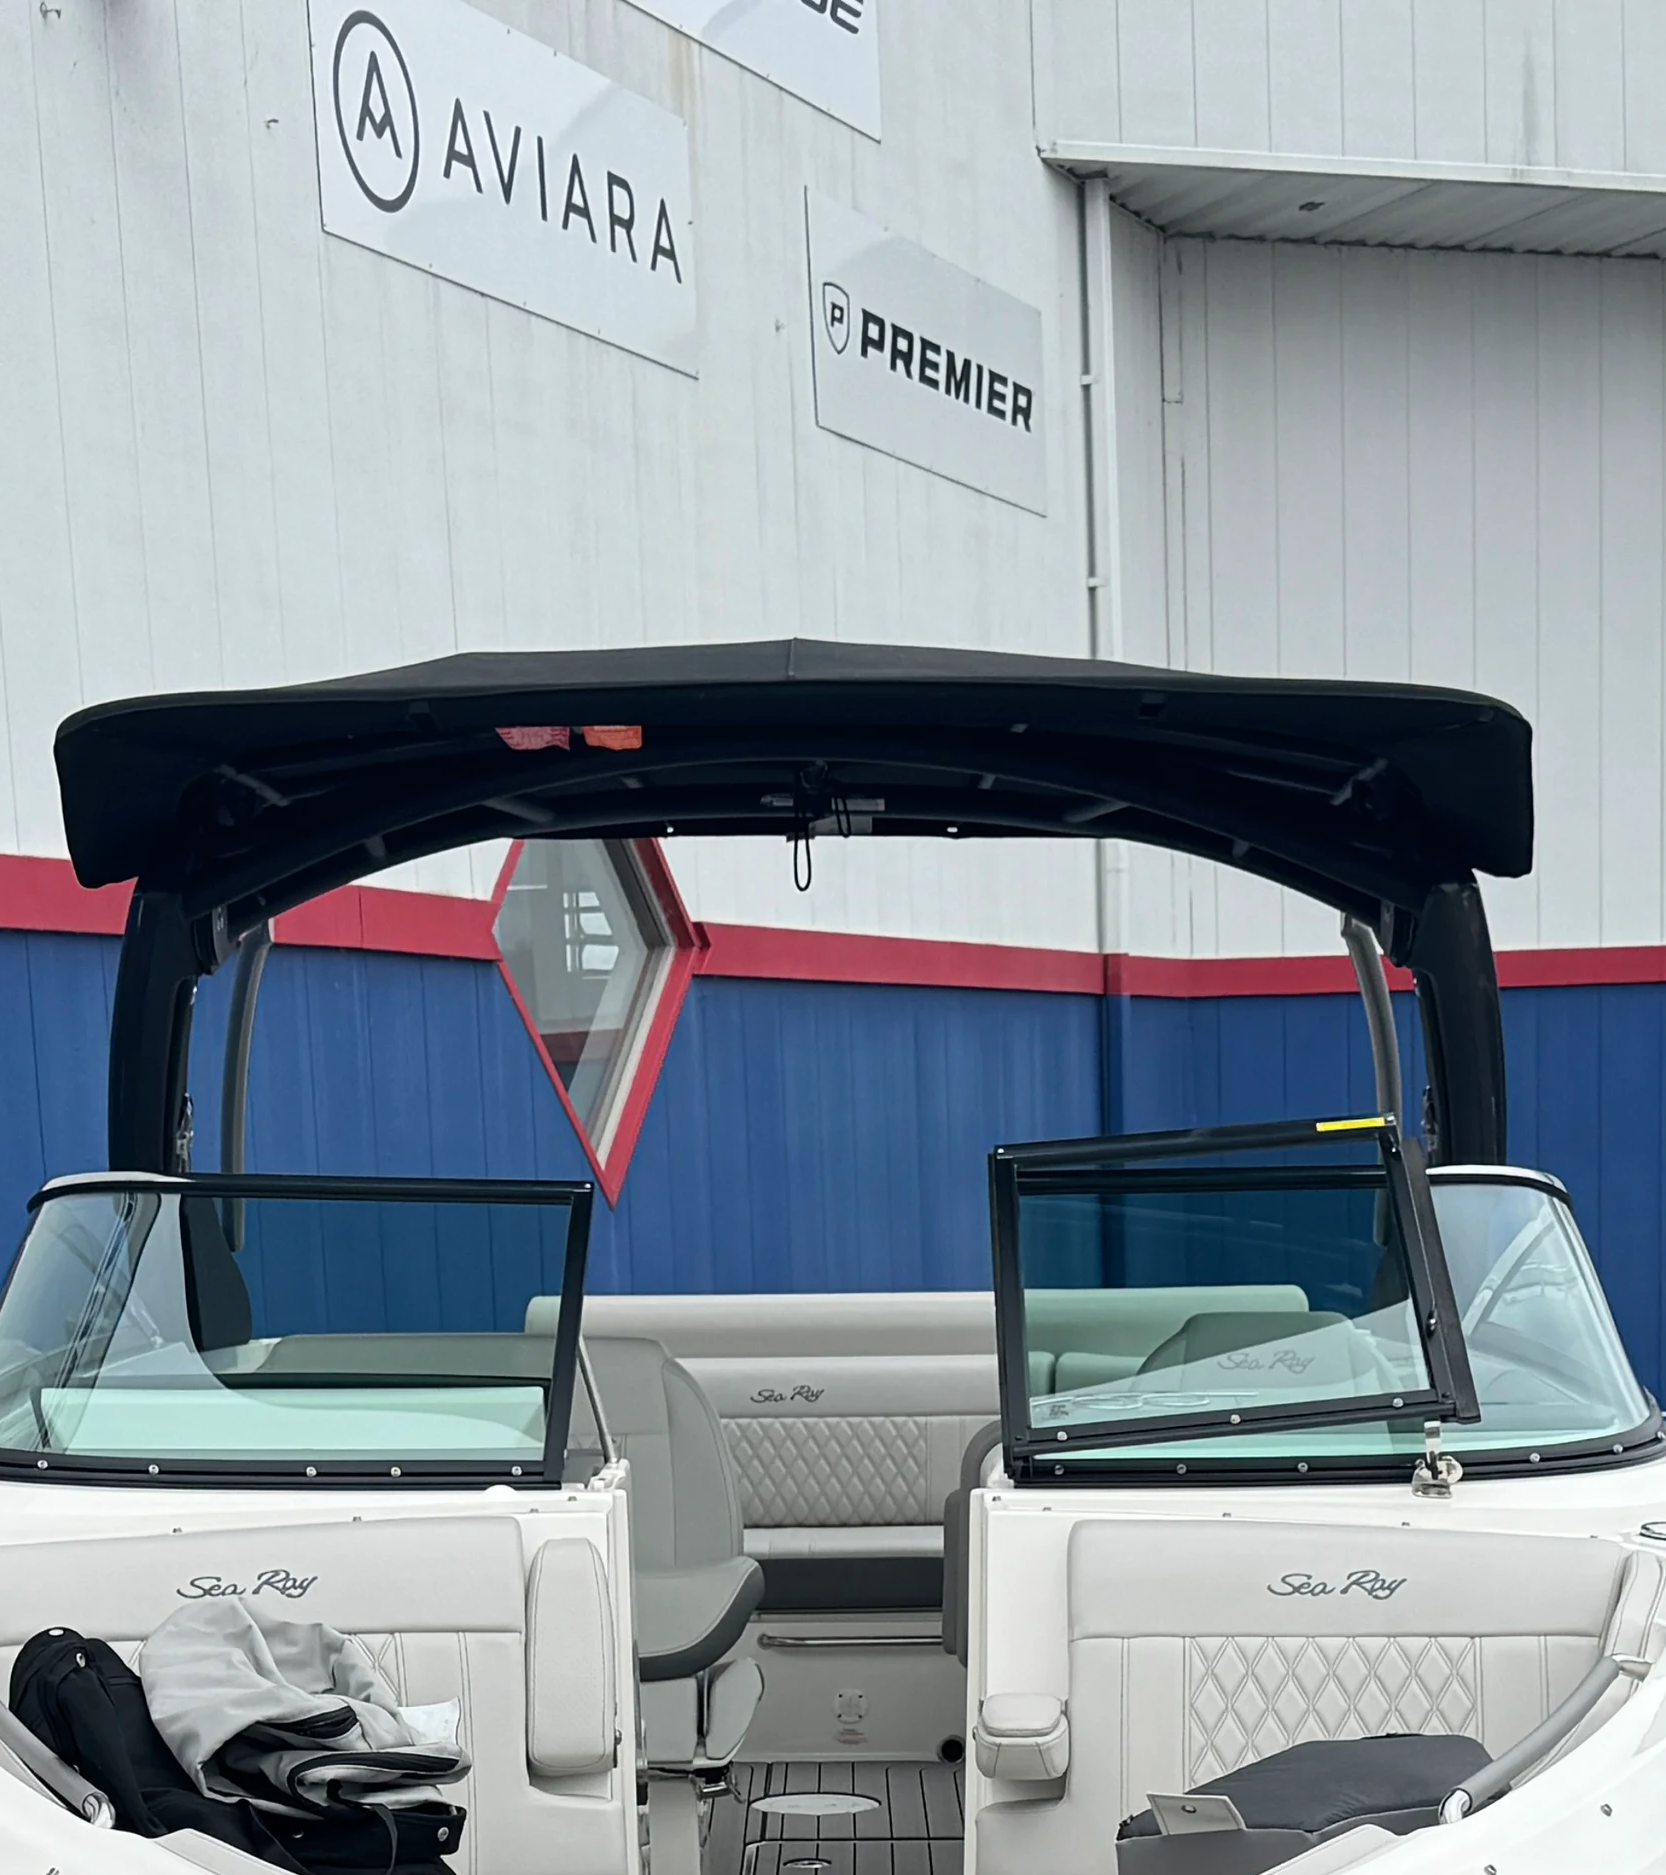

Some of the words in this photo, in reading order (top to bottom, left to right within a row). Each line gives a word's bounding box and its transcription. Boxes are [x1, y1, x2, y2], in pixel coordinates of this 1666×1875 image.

[443, 97, 682, 285] AVIARA
[860, 308, 1032, 433] PREMIER
[1217, 1352, 1264, 1370] Sea
[1268, 1349, 1316, 1375] Ray
[750, 1389, 787, 1404] Sea
[790, 1384, 825, 1403] Ray
[176, 1576, 247, 1599] Sea
[251, 1569, 319, 1599] Ray
[1266, 1573, 1337, 1597] Sea
[1340, 1569, 1408, 1600] Ray
